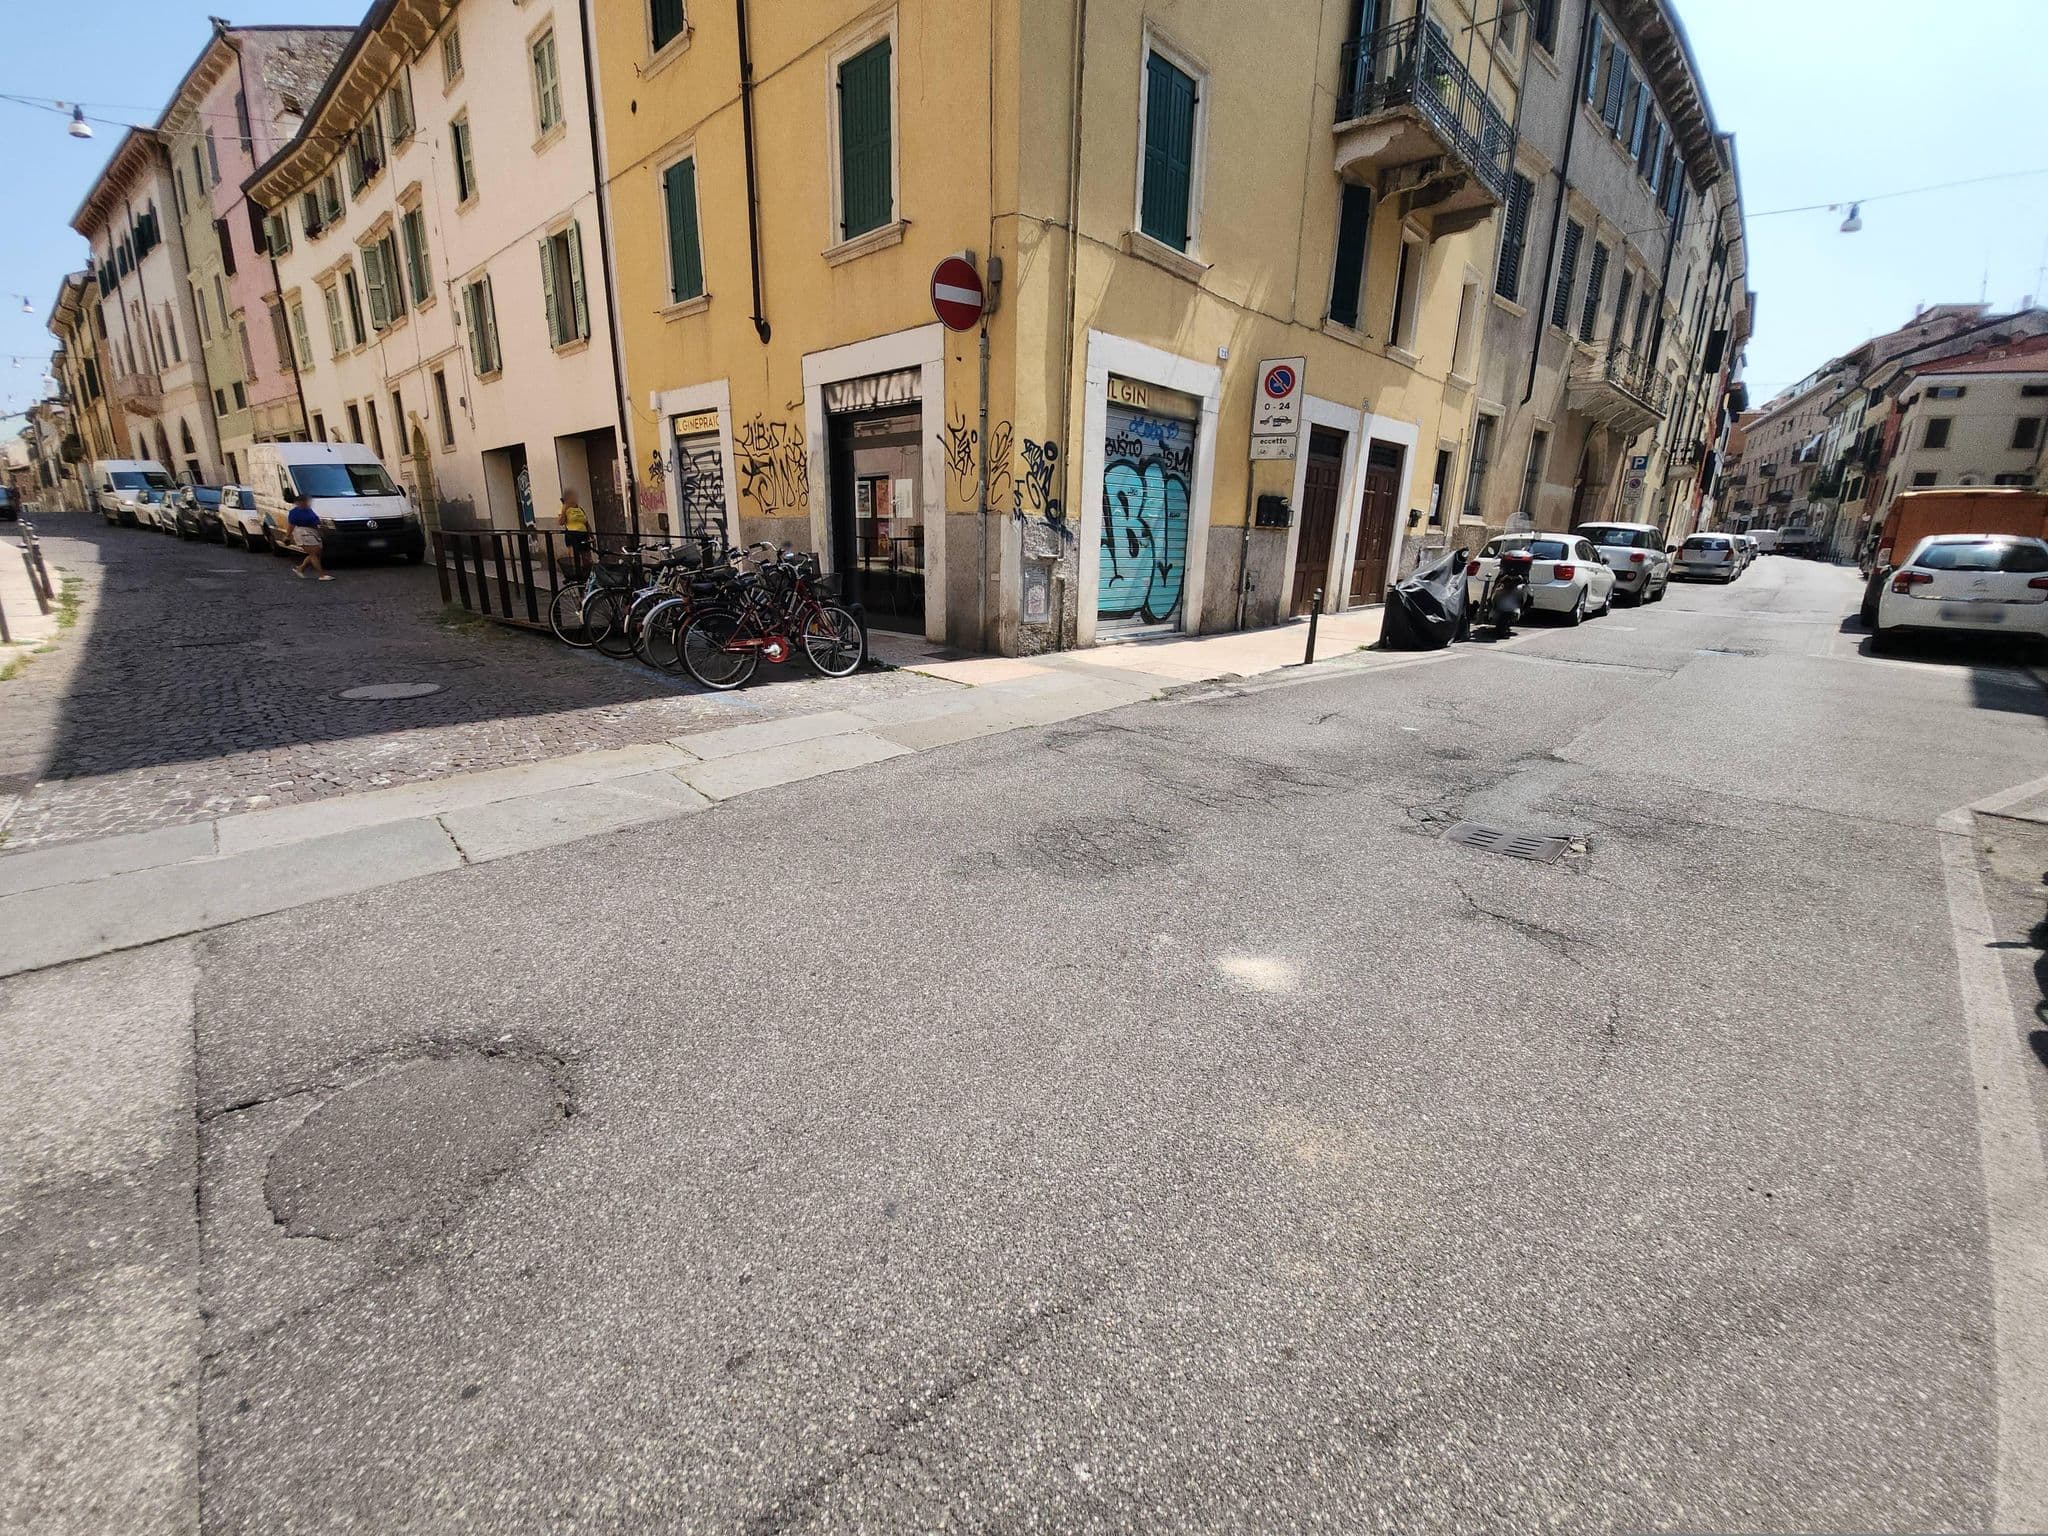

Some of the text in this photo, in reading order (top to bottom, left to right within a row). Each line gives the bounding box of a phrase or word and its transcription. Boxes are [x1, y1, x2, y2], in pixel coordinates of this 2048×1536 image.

[1121, 384, 1146, 404] GIN
[1264, 403, 1271, 411] 0
[1279, 402, 1291, 410] 24
[1634, 458, 1645, 468] P
